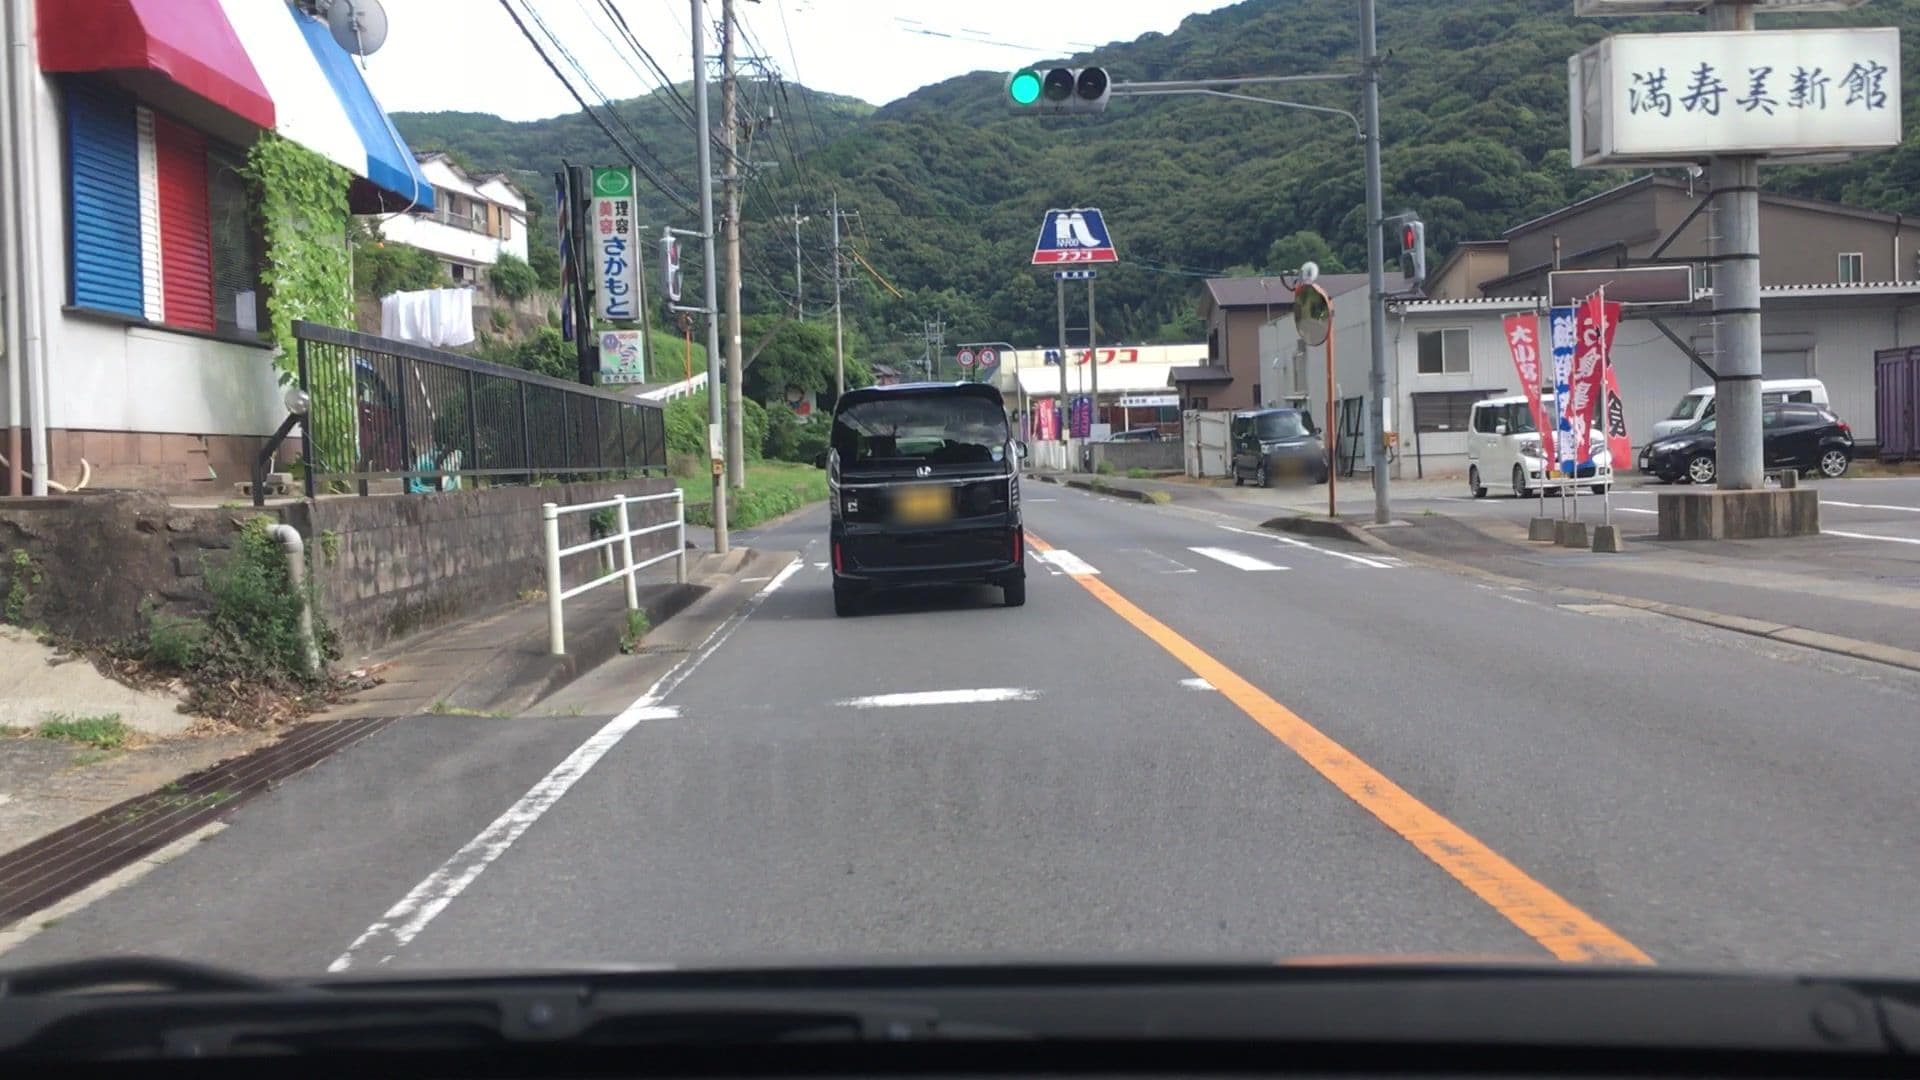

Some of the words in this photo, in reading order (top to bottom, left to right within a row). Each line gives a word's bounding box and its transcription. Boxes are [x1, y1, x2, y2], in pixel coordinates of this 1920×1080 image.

[1629, 60, 1888, 117] 満寿美新館
[599, 200, 614, 234] 美容
[615, 200, 629, 234] 理容
[1057, 250, 1093, 261] ナフコ
[603, 236, 630, 316] さかもと
